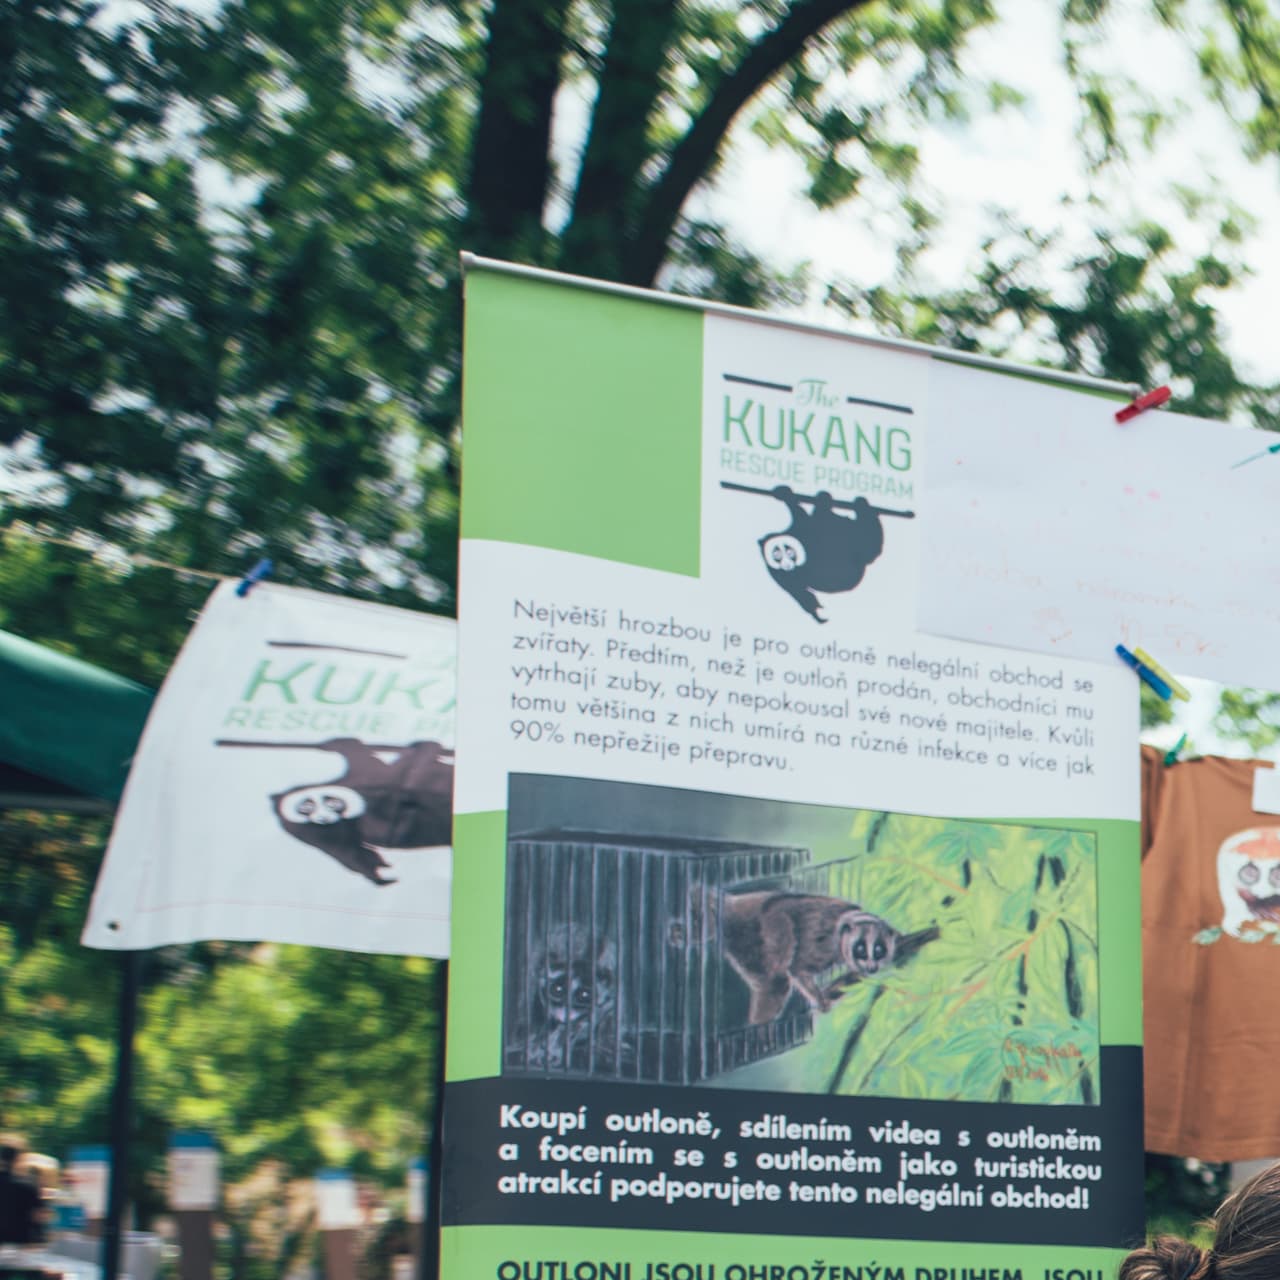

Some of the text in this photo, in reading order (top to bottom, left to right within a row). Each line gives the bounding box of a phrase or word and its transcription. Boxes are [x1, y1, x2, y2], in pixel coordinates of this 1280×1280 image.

[796, 378, 840, 409] The
[722, 393, 912, 472] KUKANG
[719, 448, 914, 500] RESCUE PROGRAM
[513, 599, 1095, 694] Největší hrozbou je pro outloně nelegální obchod se
[243, 659, 457, 712] KUK
[512, 632, 1095, 721] zvířaty. Předtím, než je outloň prodán, obchodníci mu
[223, 706, 388, 733] RESCUE
[511, 661, 1094, 748] vytrhají zuby, aby nepokousal své nové majitele. Kvůli
[509, 718, 795, 772] 90% nepřežije přepravu.
[510, 693, 1096, 778] tomu většina z nich umírá na různé infekce a více jak
[501, 1104, 1101, 1151] Koupí outloně, sdílením videa s outloněm
[499, 1136, 1101, 1180] a focením se s outloněm jako turistickou
[498, 1169, 1089, 1211] atrakcí podporujete tento nelegální obchod!
